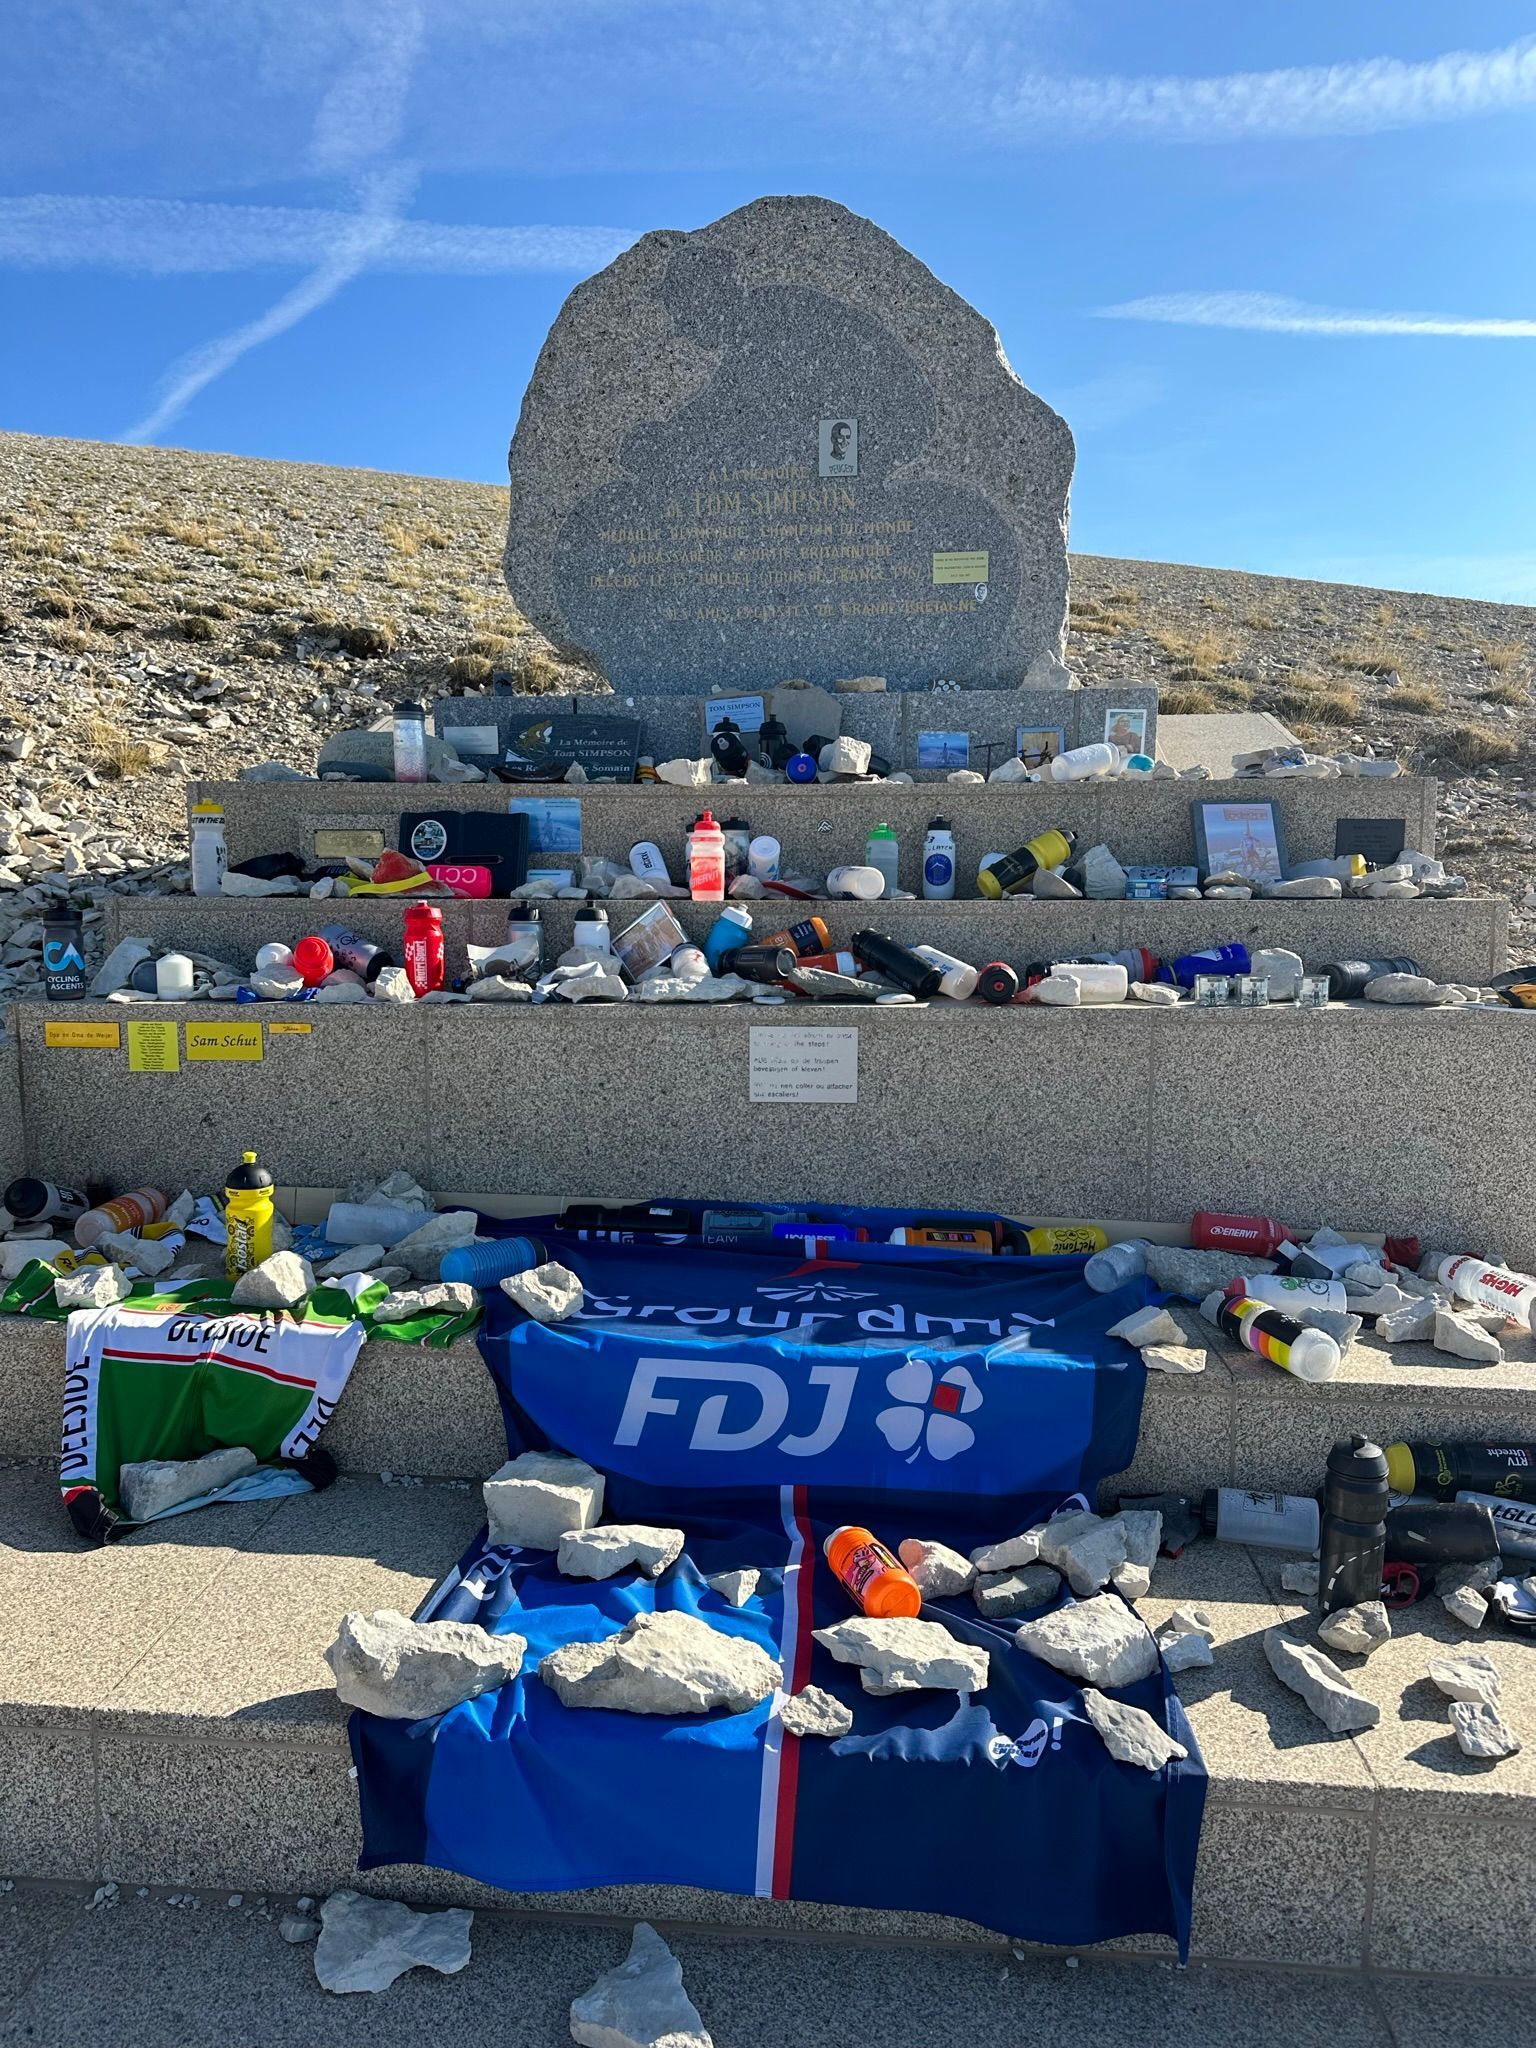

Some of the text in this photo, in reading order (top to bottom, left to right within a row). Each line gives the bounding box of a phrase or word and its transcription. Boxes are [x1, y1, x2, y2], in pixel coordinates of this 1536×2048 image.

[695, 492, 741, 515] TOM
[752, 489, 856, 514] SIMPSON
[727, 702, 760, 711] SIMPSON
[553, 749, 632, 757] Tom SIMPSON
[592, 764, 630, 772] Somain
[50, 982, 84, 990] ASCENTS
[190, 1034, 258, 1047] Sam Schut
[1223, 1226, 1259, 1239] ENERVIT
[613, 1357, 859, 1456] FDJ
[1487, 1448, 1526, 1458] Utrecht
[1507, 1456, 1529, 1466] RTV
